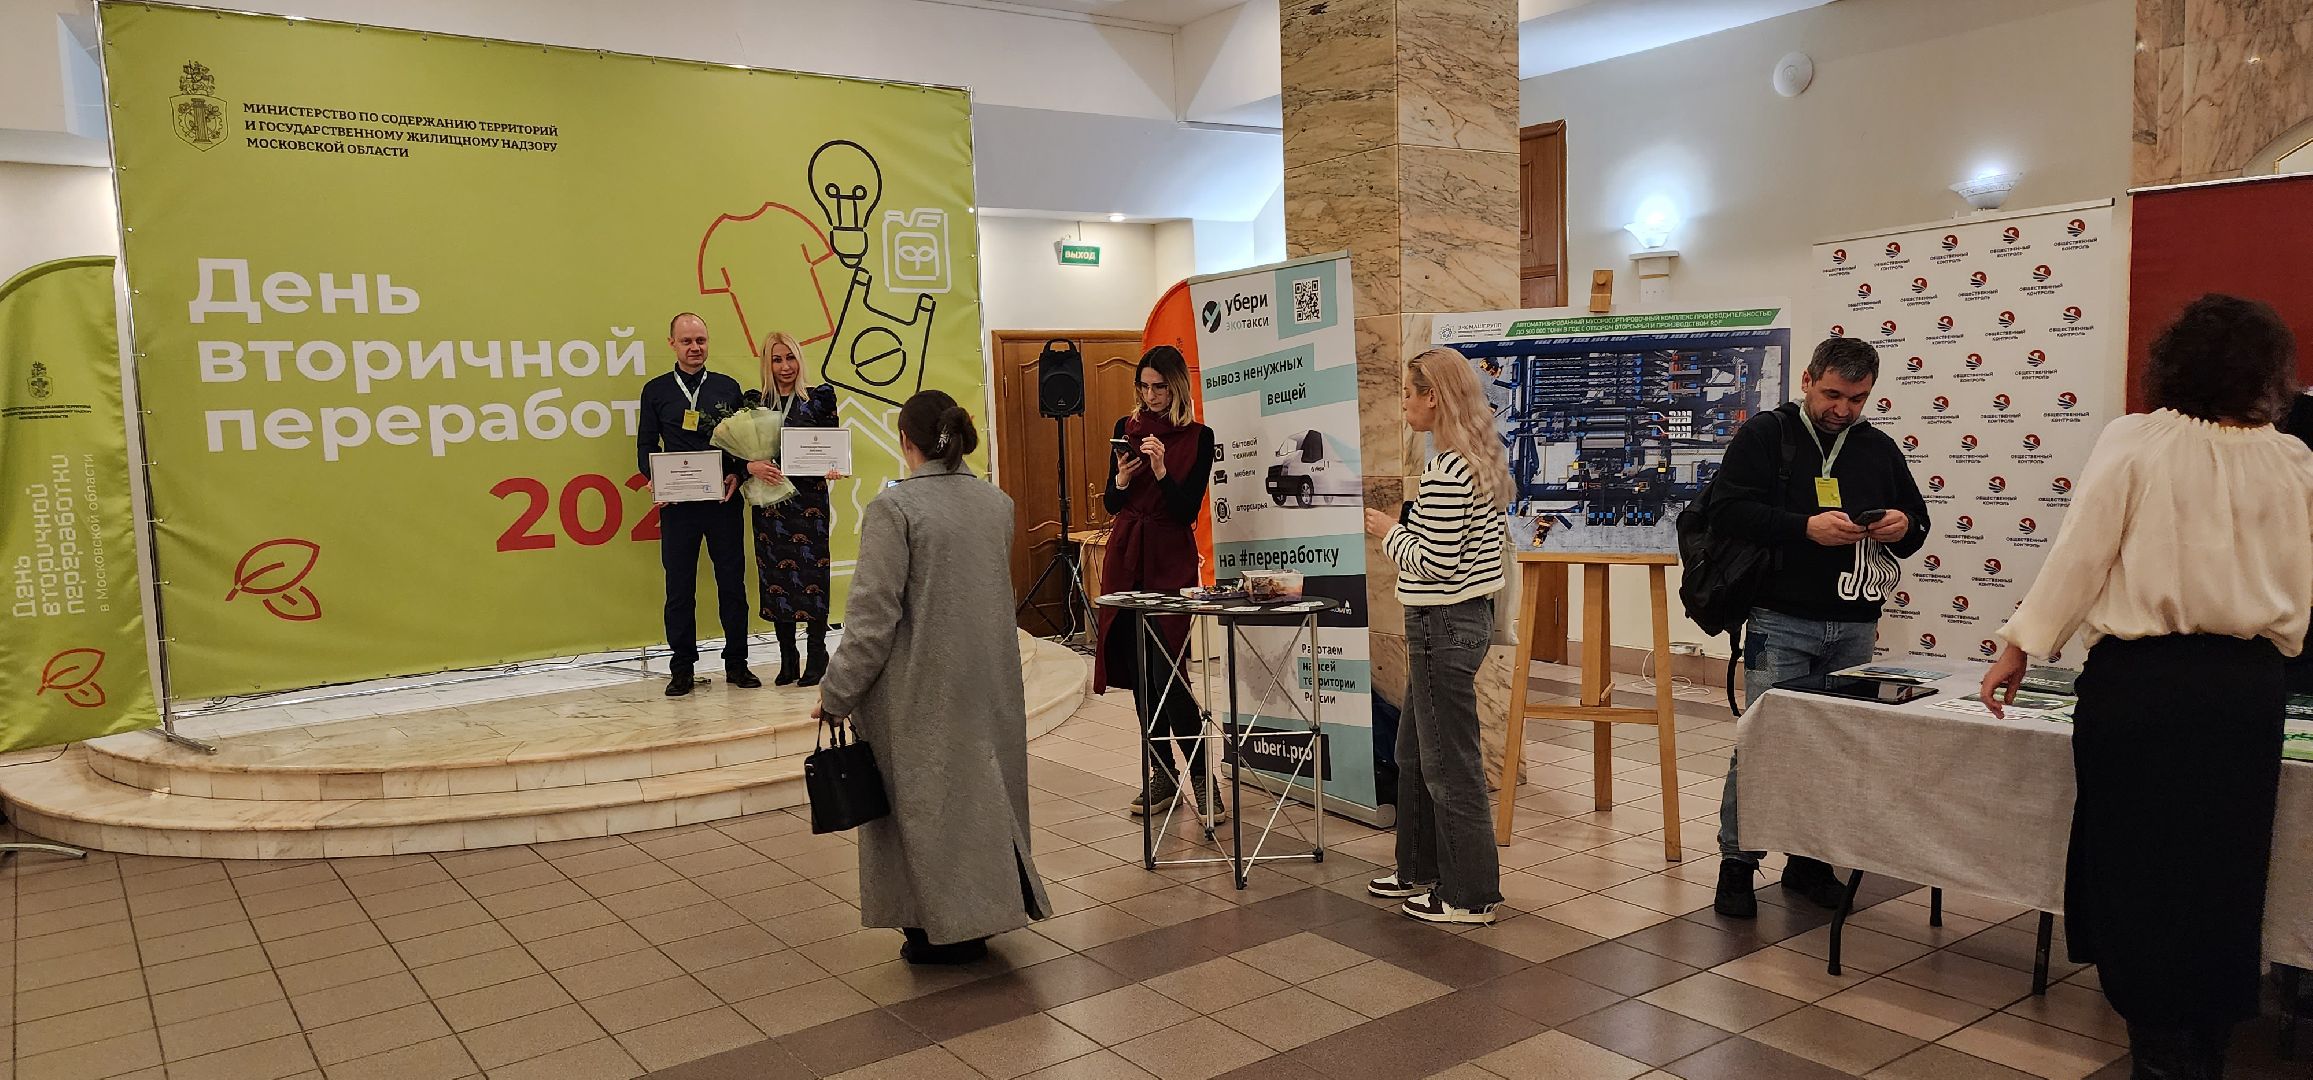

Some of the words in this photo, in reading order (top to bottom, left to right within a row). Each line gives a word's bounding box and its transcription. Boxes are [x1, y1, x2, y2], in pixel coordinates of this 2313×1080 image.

[243, 103, 356, 120] МИНИСТЕРСТВО
[359, 112, 378, 122] ПО
[381, 114, 476, 130] СОДЕРЖАНИЮ
[479, 121, 558, 136] ТЕРРИТОРИЙ
[245, 120, 256, 131] И
[259, 121, 403, 141] ГОСУДАРСТВЕННОМУ
[407, 132, 499, 148] ЖИЛИЩНОМУ
[501, 139, 557, 152] НАДЗОРУ
[247, 138, 344, 153] МОСКОВСКОЙ
[348, 144, 409, 157] ОБЛАСТИ
[1065, 250, 1096, 260] ВЫХОД
[189, 257, 420, 324] День
[1225, 292, 1268, 316] убери
[1226, 316, 1269, 331] экотакси
[198, 326, 647, 393] вторичной
[1206, 371, 1241, 389] вывоз
[1243, 356, 1303, 380] ненужных
[1267, 382, 1306, 405] вещей
[205, 387, 640, 461] переработ
[1231, 437, 1258, 449] бытовой
[84, 454, 98, 511] области
[1234, 469, 1256, 478] мебели
[489, 473, 661, 552] 202
[1236, 501, 1268, 513] вторсырья
[52, 454, 86, 614] переработки
[26, 484, 61, 616] вторичной
[87, 515, 109, 600] Московской
[1219, 553, 1236, 567] на
[1239, 545, 1340, 570] #переработку
[13, 555, 37, 617] День
[101, 603, 110, 612] в
[1302, 644, 1343, 655] Раотаем
[1303, 677, 1356, 690] територии
[1253, 737, 1313, 763] uberi.pro
